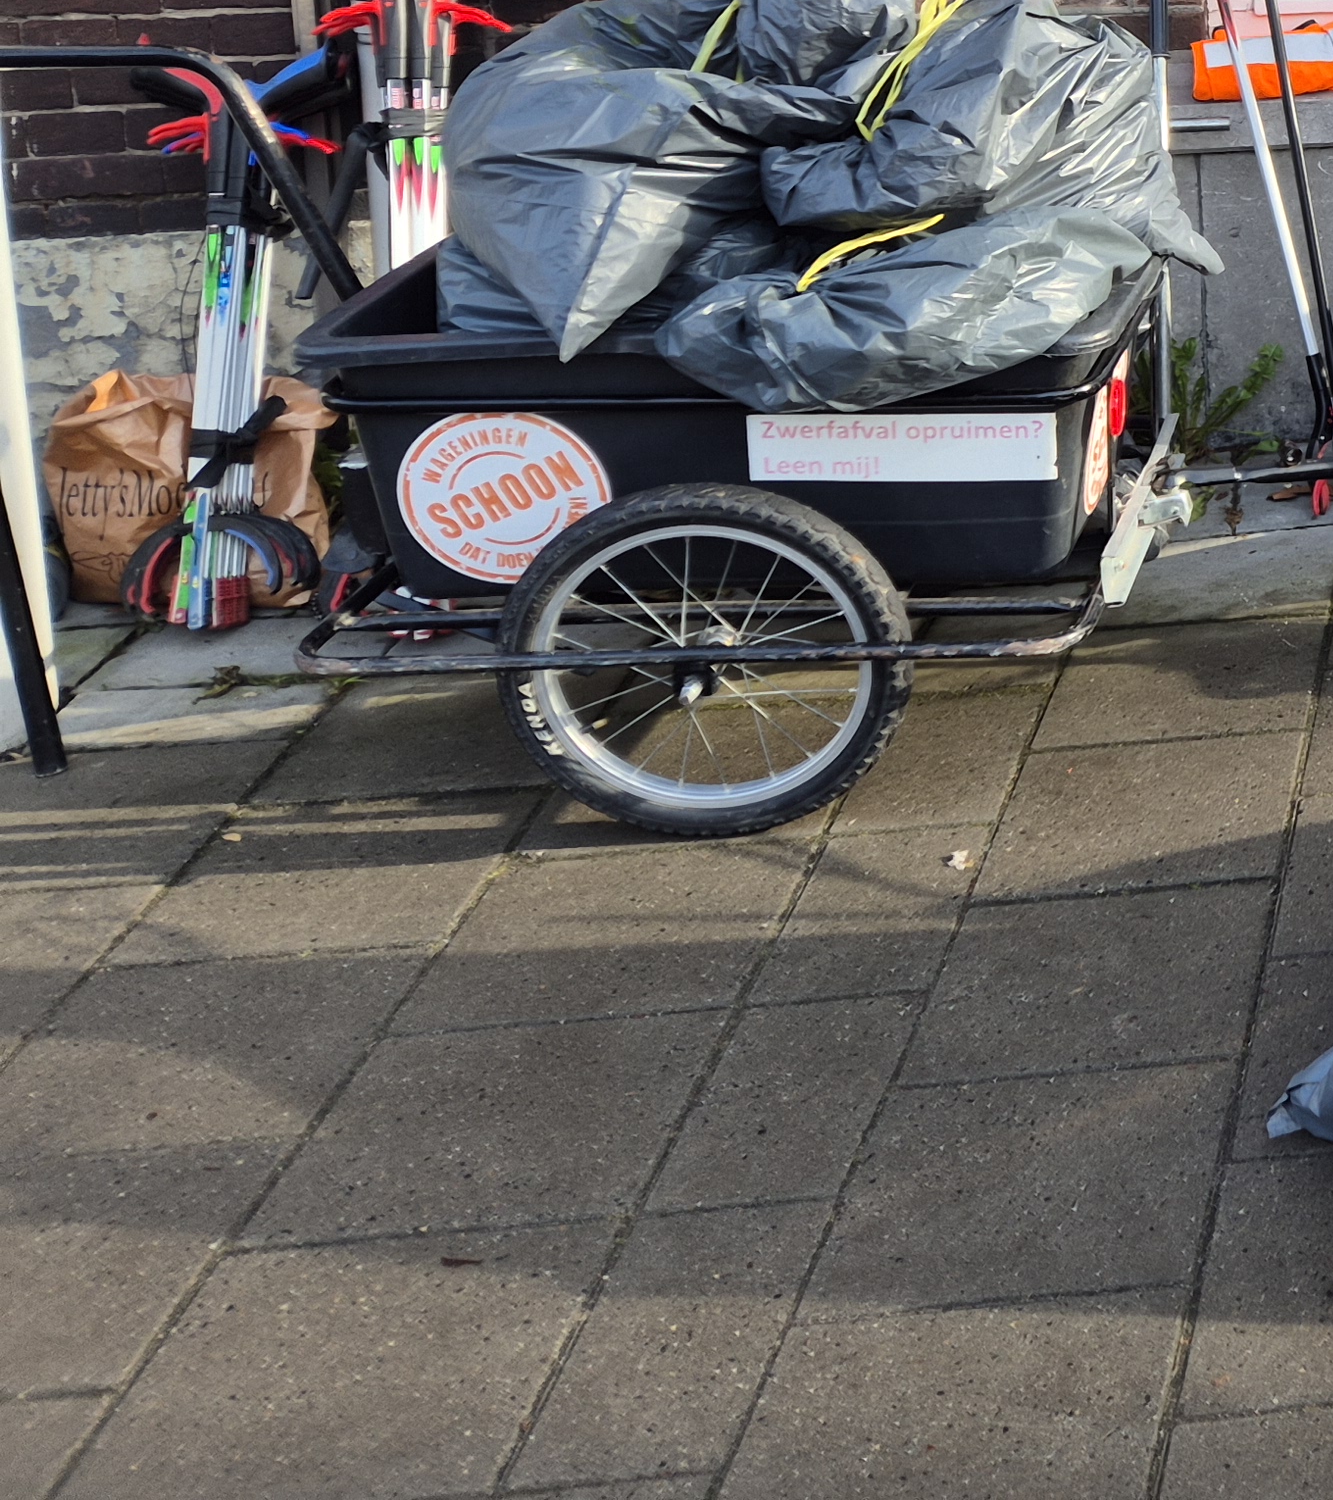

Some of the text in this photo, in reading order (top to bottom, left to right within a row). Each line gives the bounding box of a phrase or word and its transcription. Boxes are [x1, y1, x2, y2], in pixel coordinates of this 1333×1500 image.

[760, 419, 1045, 444] Zwerfafval opruimen?
[421, 427, 528, 485] WAGENINGEN
[763, 456, 881, 479] Leen mij!
[426, 450, 585, 539] SCHOON
[458, 541, 491, 564] DAT
